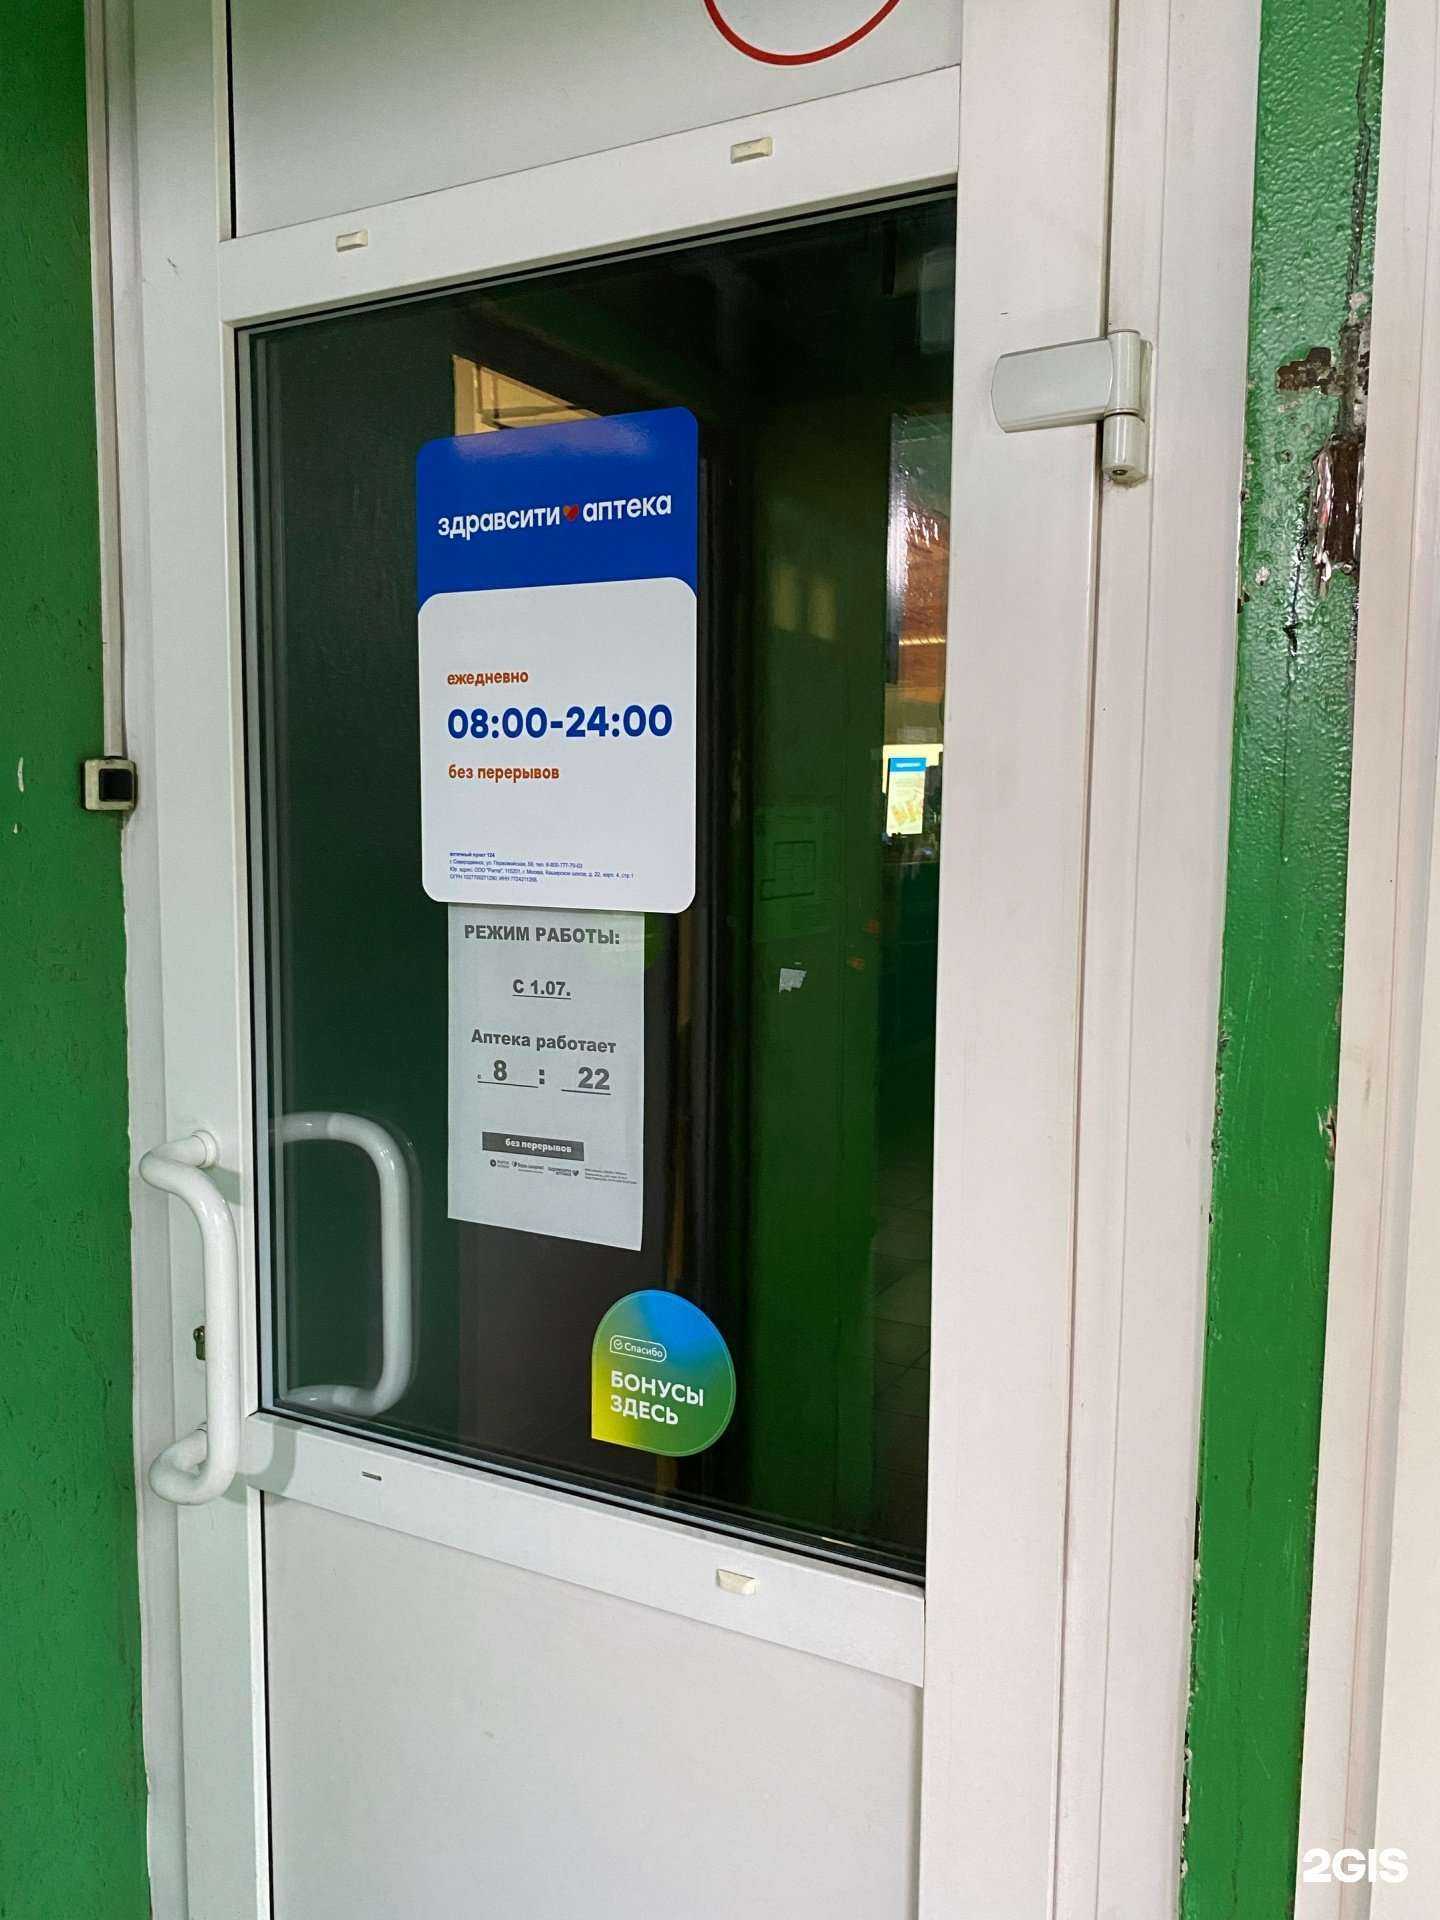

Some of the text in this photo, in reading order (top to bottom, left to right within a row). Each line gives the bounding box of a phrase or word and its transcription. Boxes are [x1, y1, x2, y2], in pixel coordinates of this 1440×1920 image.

[437, 494, 672, 541] здравсити аптека
[447, 671, 529, 686] ежедневно
[447, 704, 672, 739] 08:00-24:00
[448, 764, 560, 783] без перерывов
[464, 924, 620, 945] РЕЖИМ РАБОТЫ:
[512, 979, 571, 997] С 1.07.
[471, 1028, 617, 1053] Аптека работает
[493, 1059, 507, 1082] 8
[578, 1066, 611, 1091] 22
[505, 1137, 572, 1153] без перерывов
[624, 1342, 663, 1358] Спасибо
[611, 1370, 704, 1407] БОНУСЫ
[610, 1394, 679, 1425] ЗДЕСЬ
